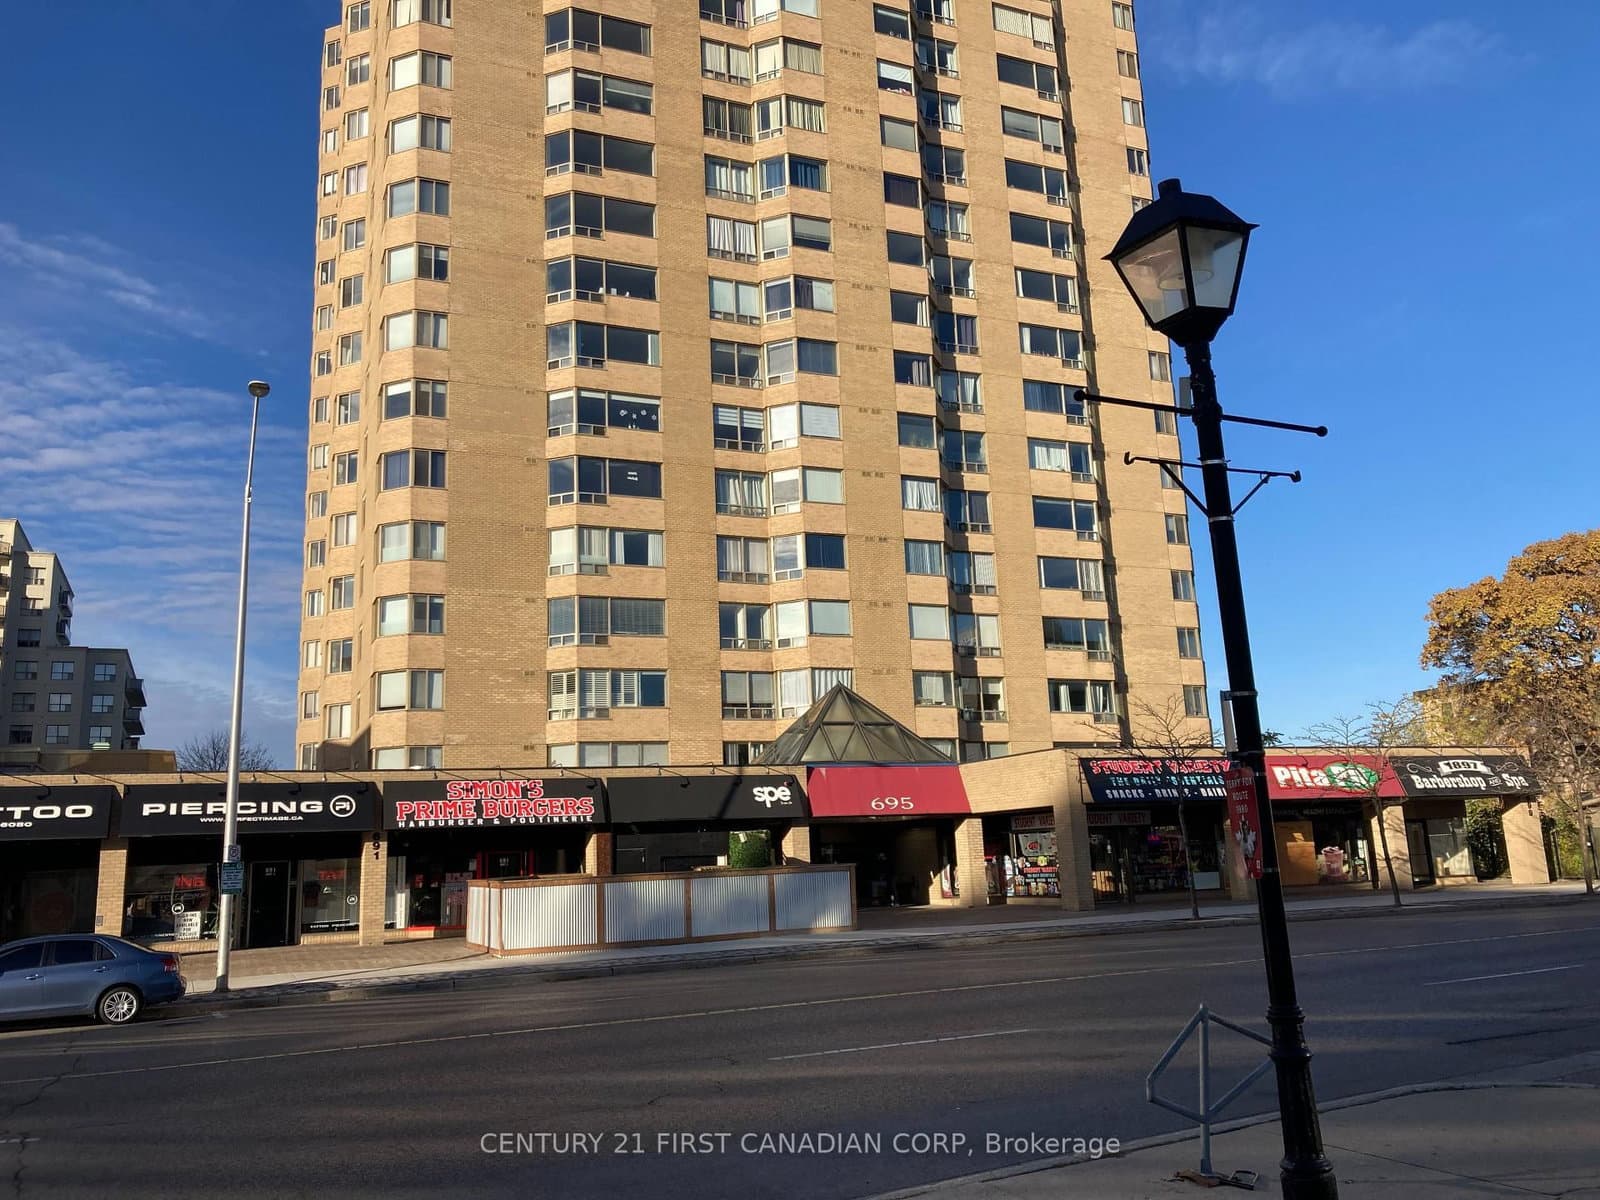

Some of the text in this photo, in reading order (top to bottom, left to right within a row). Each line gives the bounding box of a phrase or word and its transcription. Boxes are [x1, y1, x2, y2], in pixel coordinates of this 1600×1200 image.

[1090, 759, 1231, 775] STUDENT VARIETY
[1445, 761, 1478, 770] 1897
[1271, 766, 1330, 788] Pita
[1410, 774, 1487, 790] Barbershop
[1502, 773, 1529, 789] Spa
[447, 780, 543, 799] SIMON'S
[1105, 788, 1145, 799] SNACKS
[142, 801, 323, 816] PIERCING
[396, 797, 595, 821] PRIME BURGERS
[870, 796, 914, 811] 695
